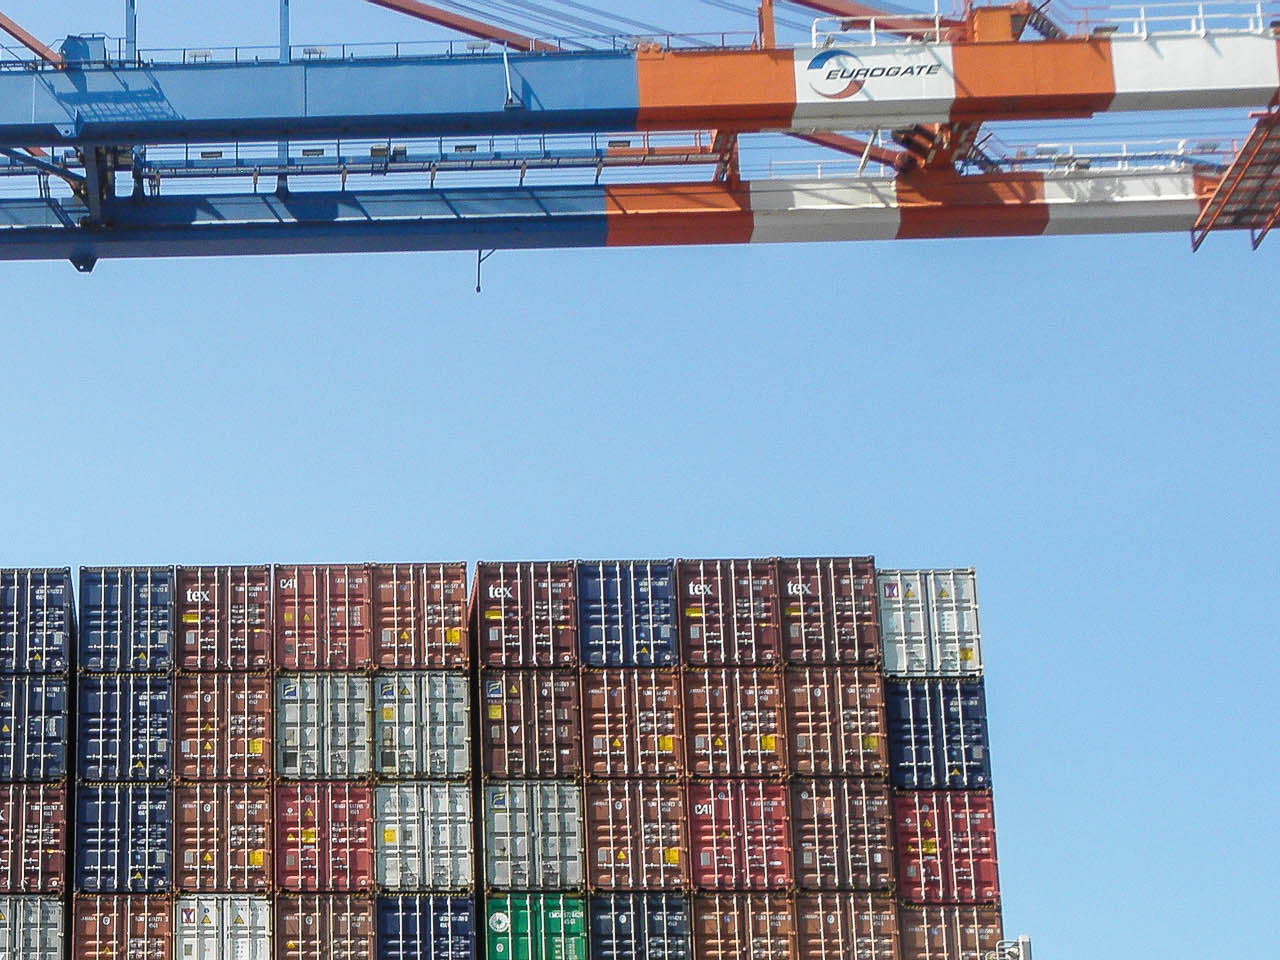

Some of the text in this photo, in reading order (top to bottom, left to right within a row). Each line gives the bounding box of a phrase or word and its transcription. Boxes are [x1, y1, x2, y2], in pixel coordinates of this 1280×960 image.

[825, 63, 942, 82] EUROGATE
[186, 587, 210, 602] tex
[488, 584, 513, 599] tex
[688, 580, 713, 595] tex
[787, 580, 812, 595] tex
